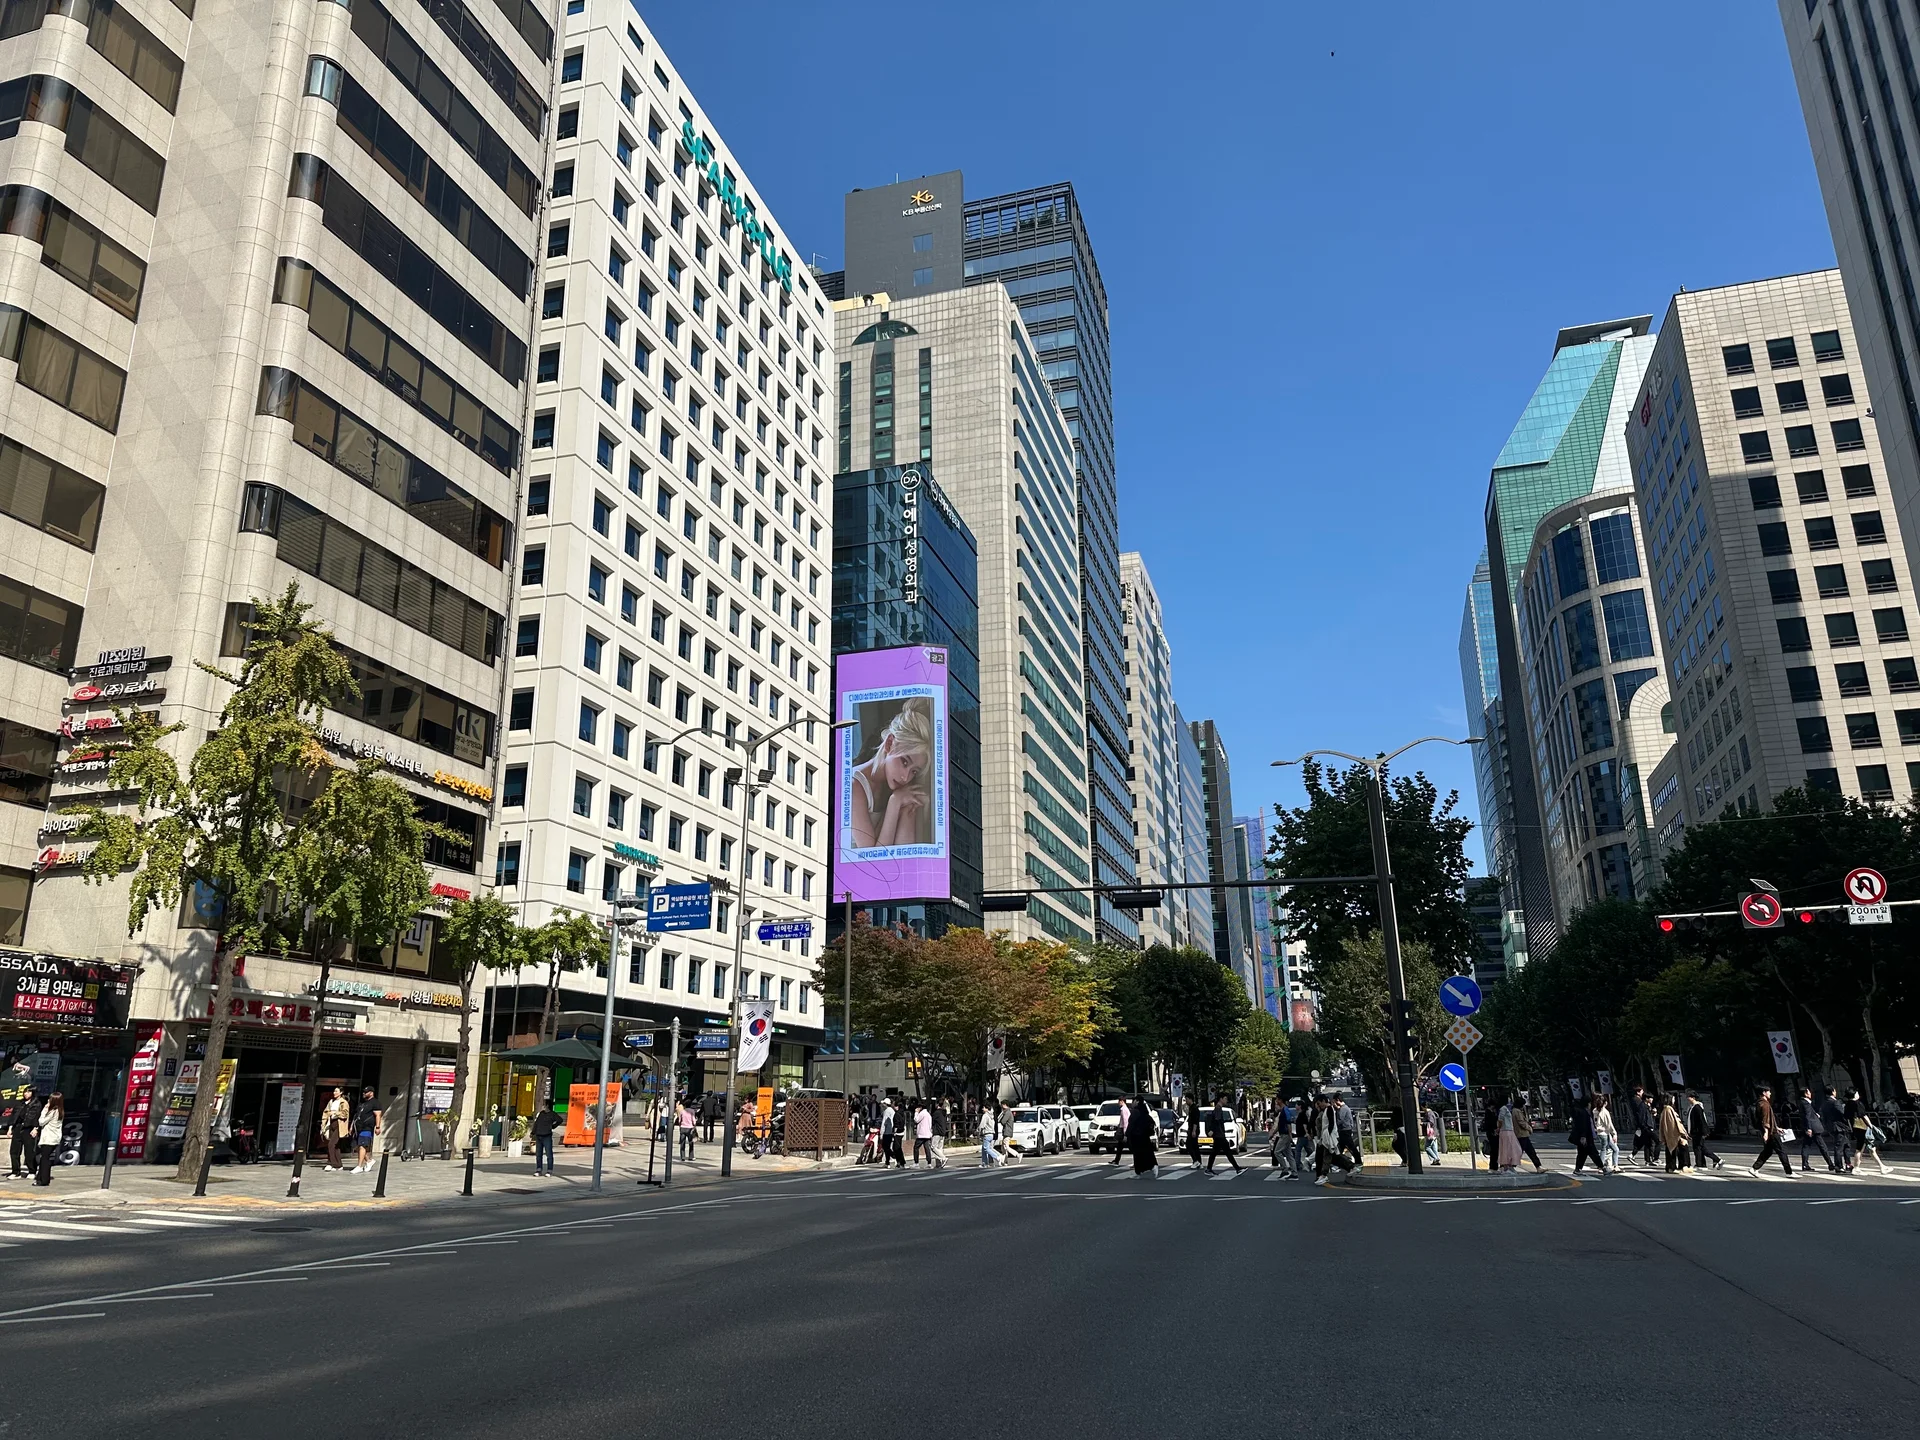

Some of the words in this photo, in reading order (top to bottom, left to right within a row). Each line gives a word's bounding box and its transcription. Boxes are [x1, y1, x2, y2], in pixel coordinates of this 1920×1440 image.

[682, 121, 792, 294] SPARKPLUS
[903, 490, 918, 604] 디에이성형외과
[656, 897, 666, 910] P
[16, 976, 50, 995] 3개월
[52, 980, 84, 998] 9만원
